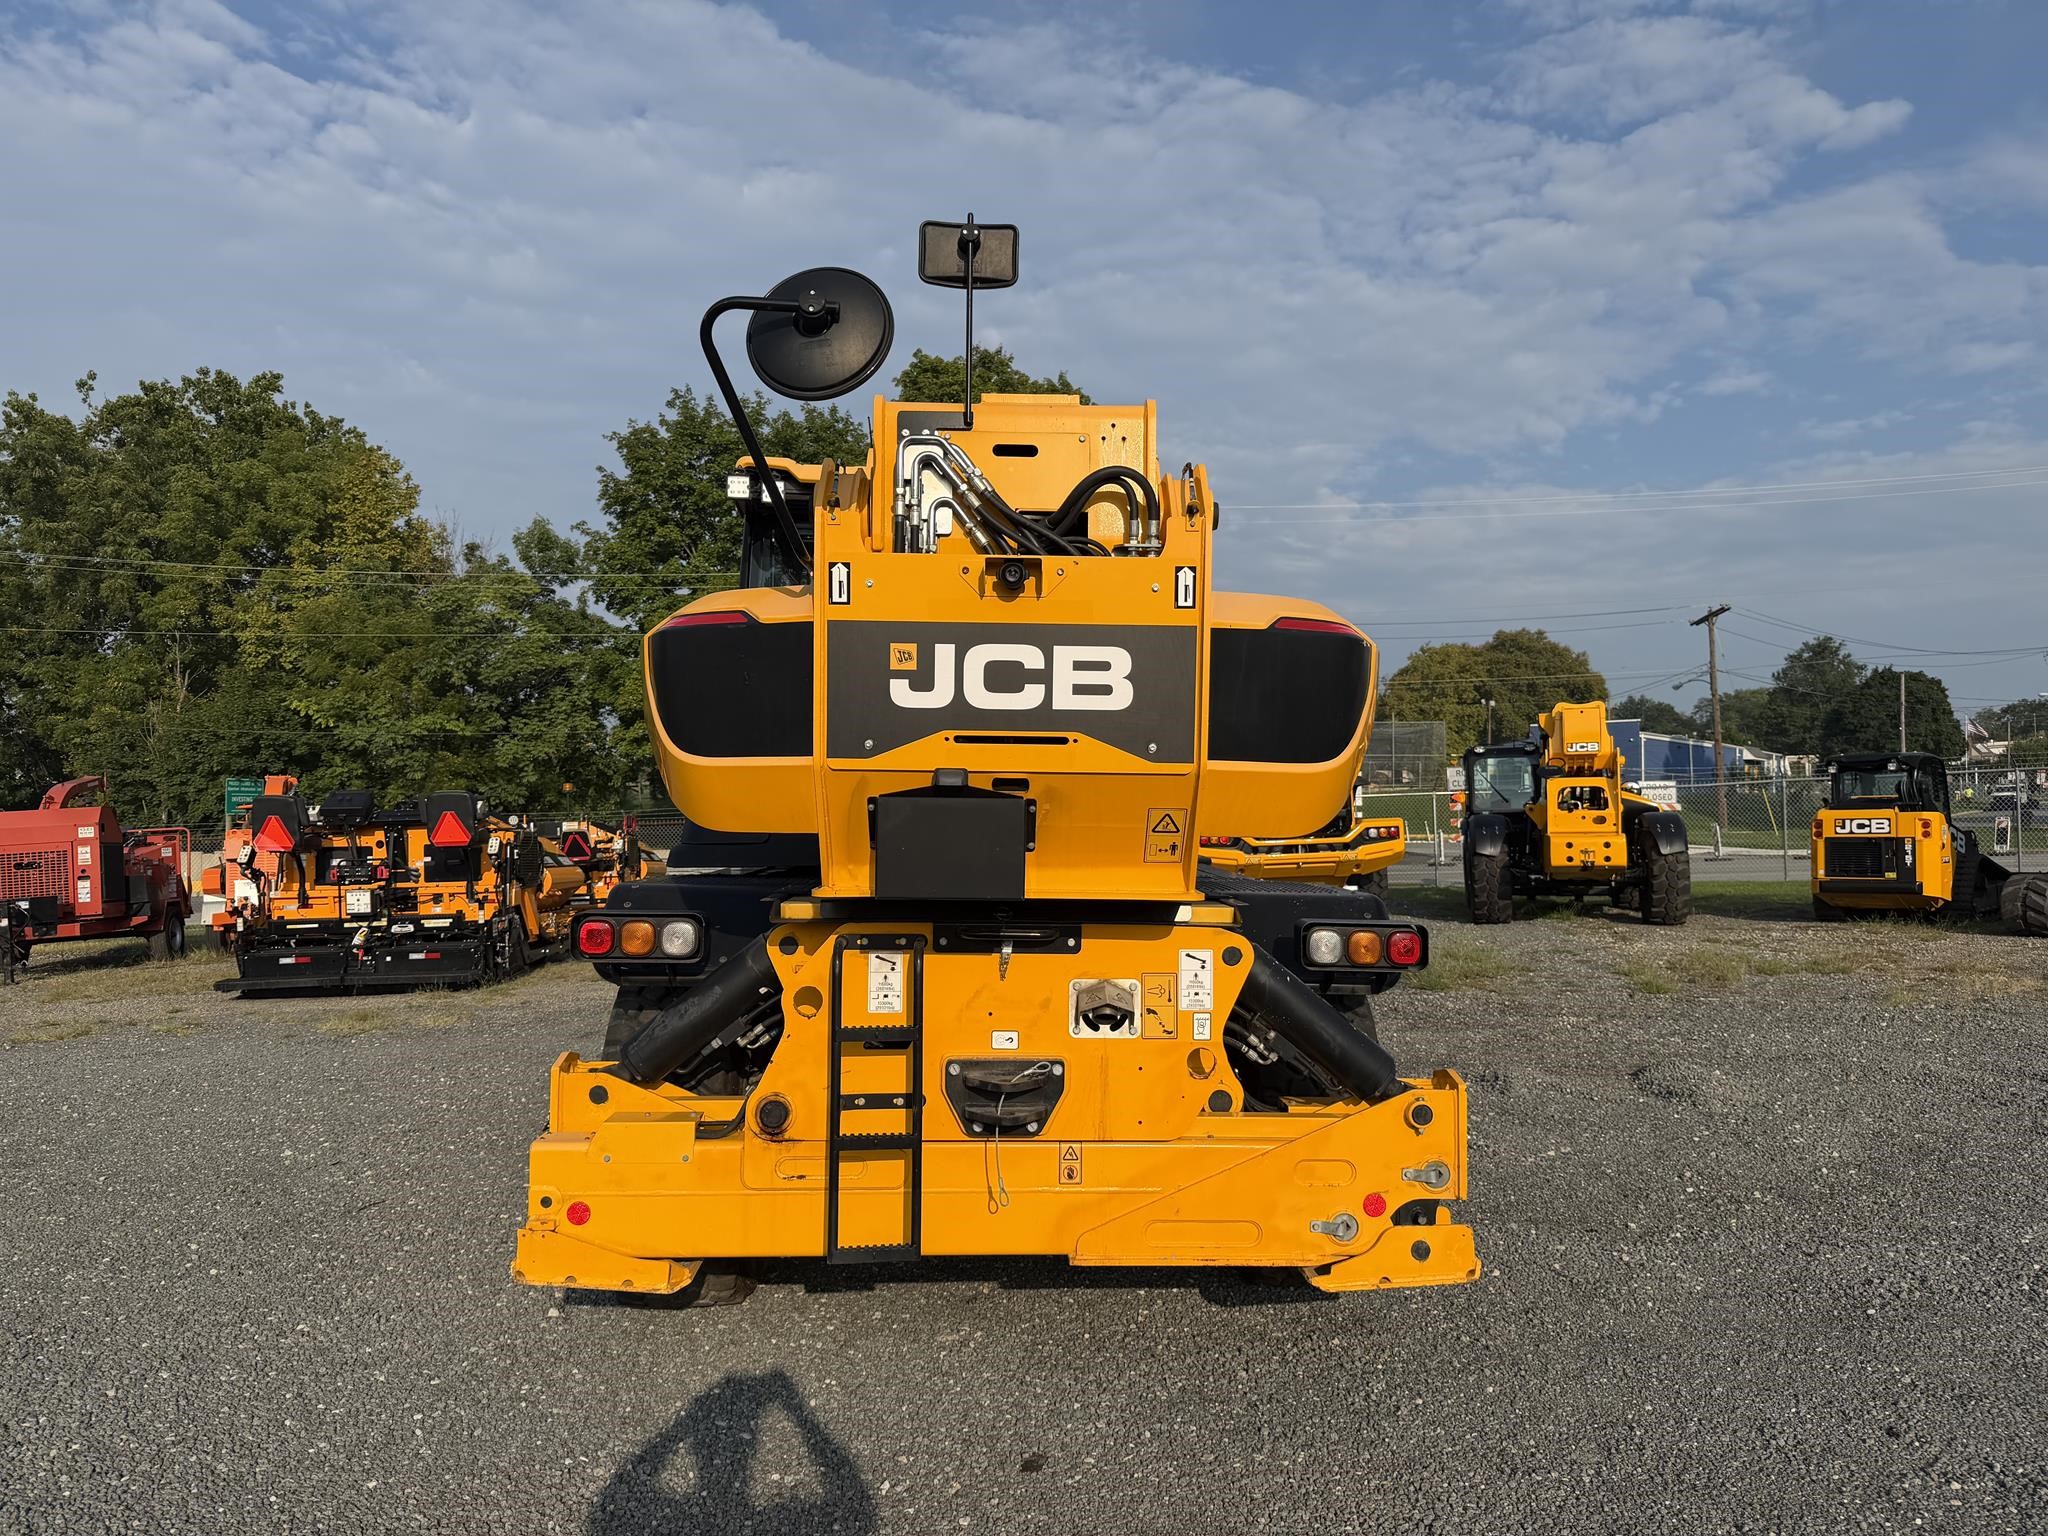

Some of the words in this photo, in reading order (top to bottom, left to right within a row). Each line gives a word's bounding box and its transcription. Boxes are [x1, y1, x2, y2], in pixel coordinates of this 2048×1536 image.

[897, 650, 913, 663] JCB
[890, 643, 1134, 711] JCB
[1567, 742, 1599, 752] JCB
[1836, 819, 1890, 834] JCB
[1949, 825, 1966, 854] CB
